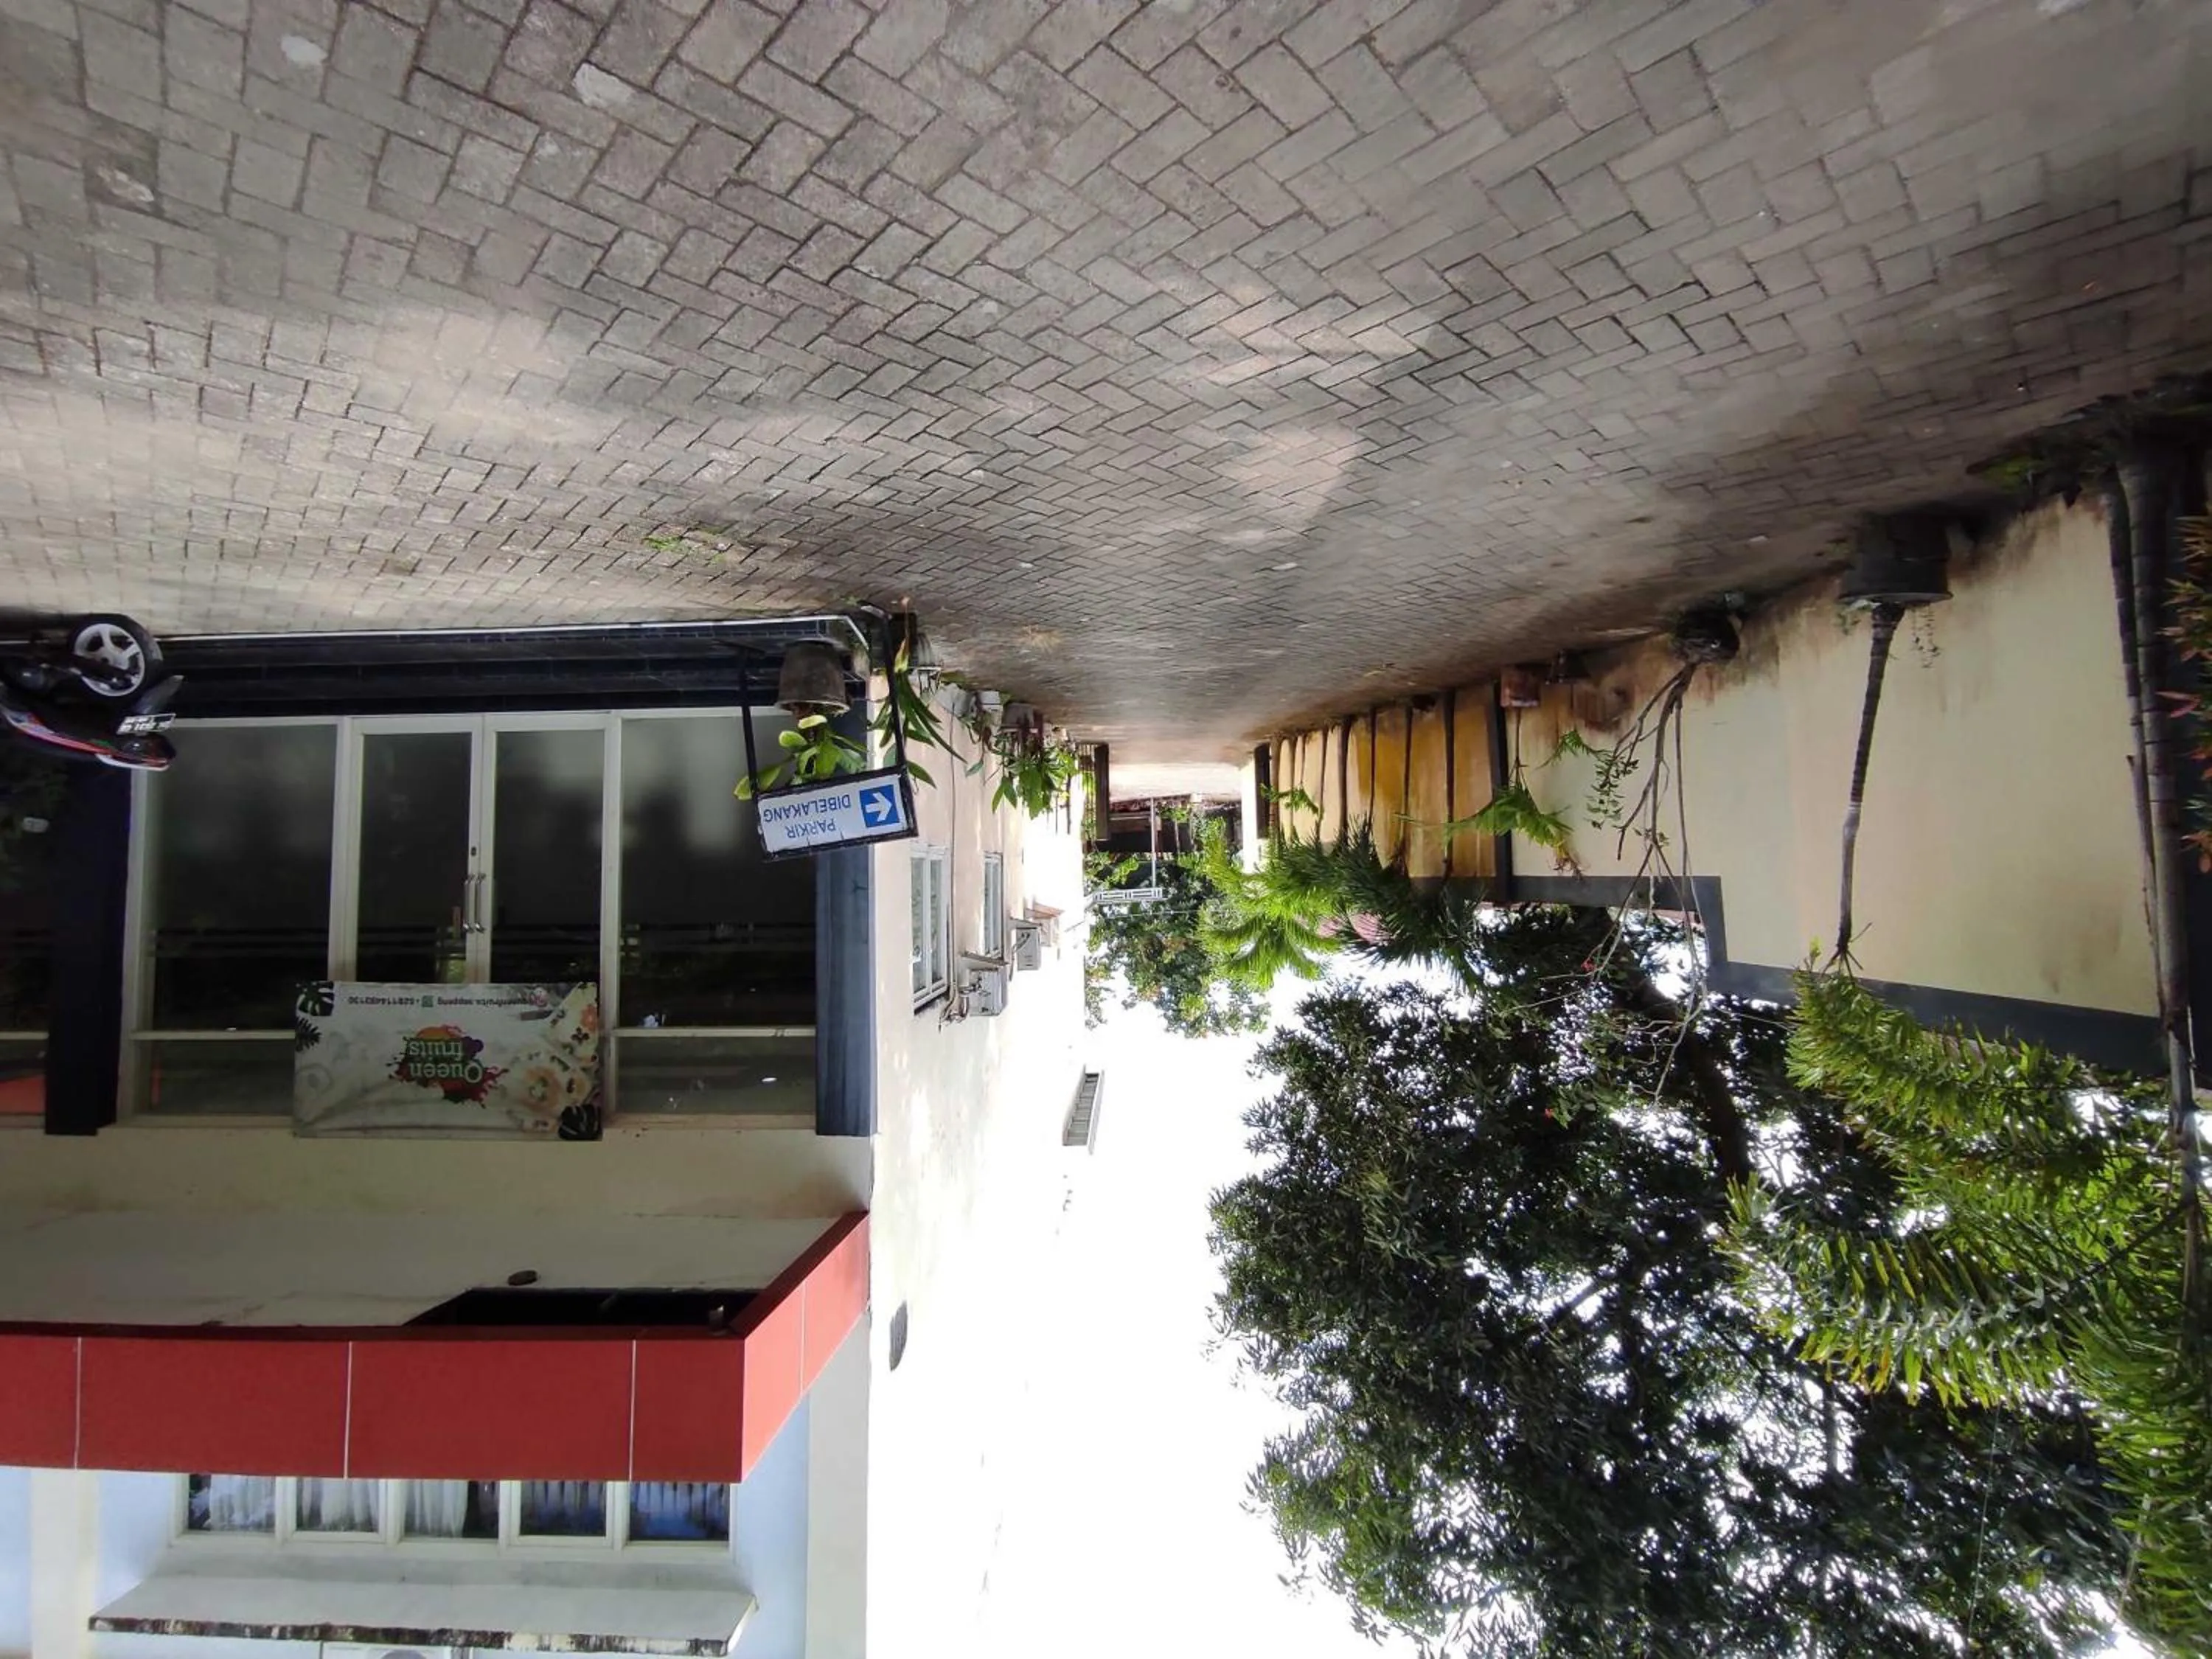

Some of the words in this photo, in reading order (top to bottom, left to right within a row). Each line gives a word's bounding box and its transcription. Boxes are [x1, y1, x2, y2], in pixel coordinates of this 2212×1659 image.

[764, 794, 851, 822] DIBELAKANG
[785, 818, 836, 838] PARKIR
[409, 1041, 463, 1061] fruits
[409, 1061, 483, 1083] Queen
